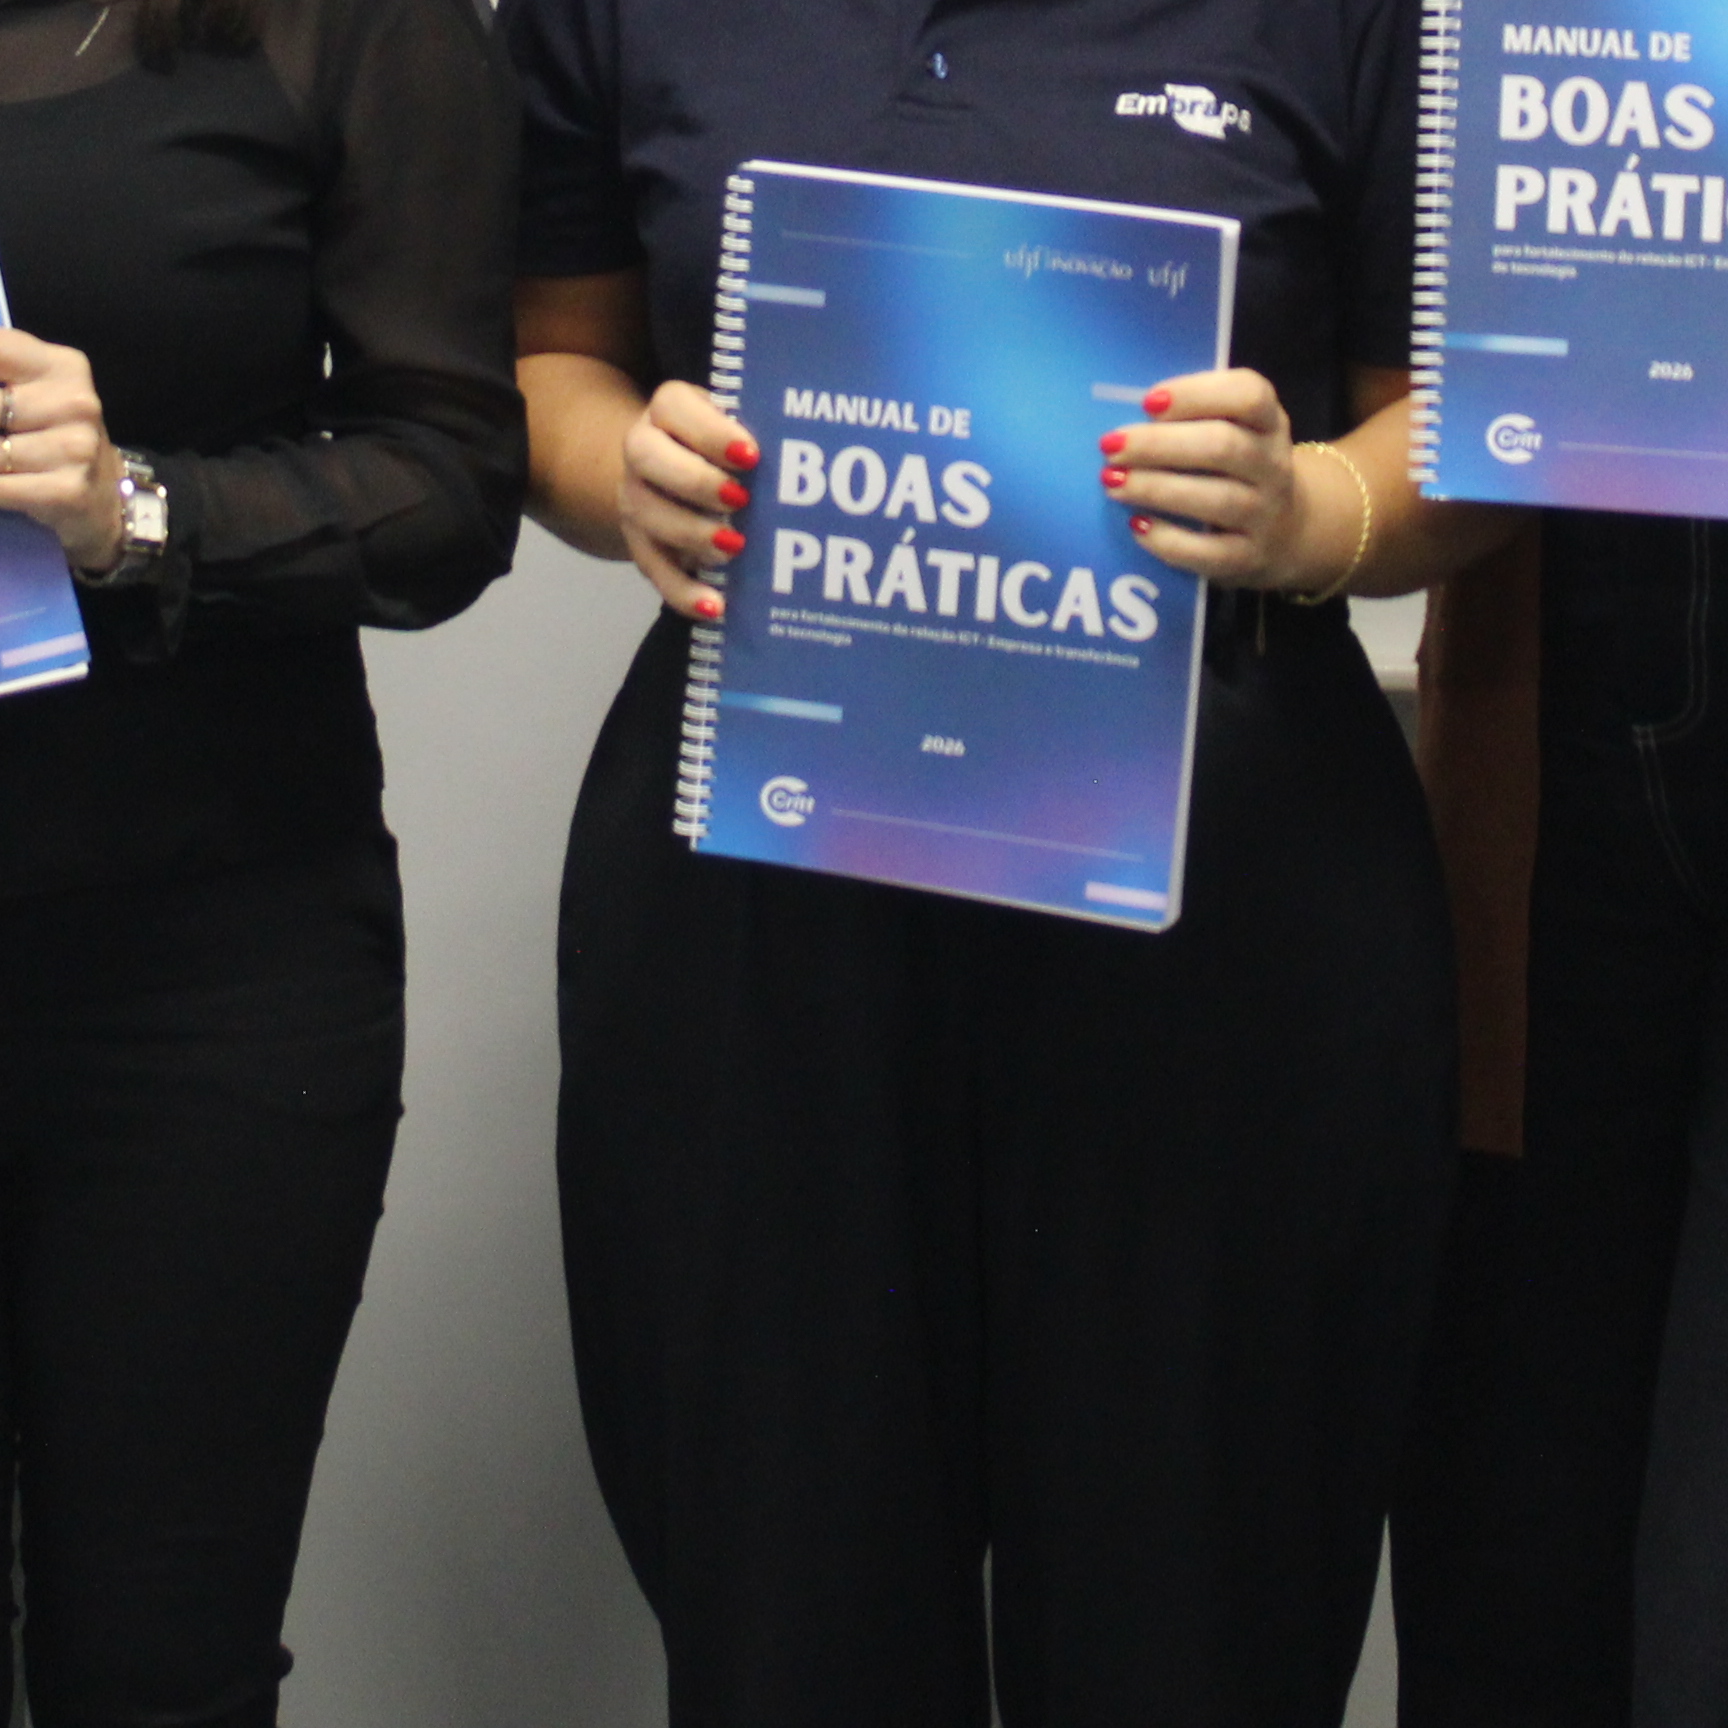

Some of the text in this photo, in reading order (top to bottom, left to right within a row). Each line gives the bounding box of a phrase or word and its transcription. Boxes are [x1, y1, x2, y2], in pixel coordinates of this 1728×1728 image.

[1503, 23, 1692, 62] MANUAL DE
[1499, 73, 1715, 150] BOAS
[783, 386, 972, 439] MANUAL DE
[777, 437, 993, 529] BOAS
[772, 526, 1161, 642] PRÁTICAS
